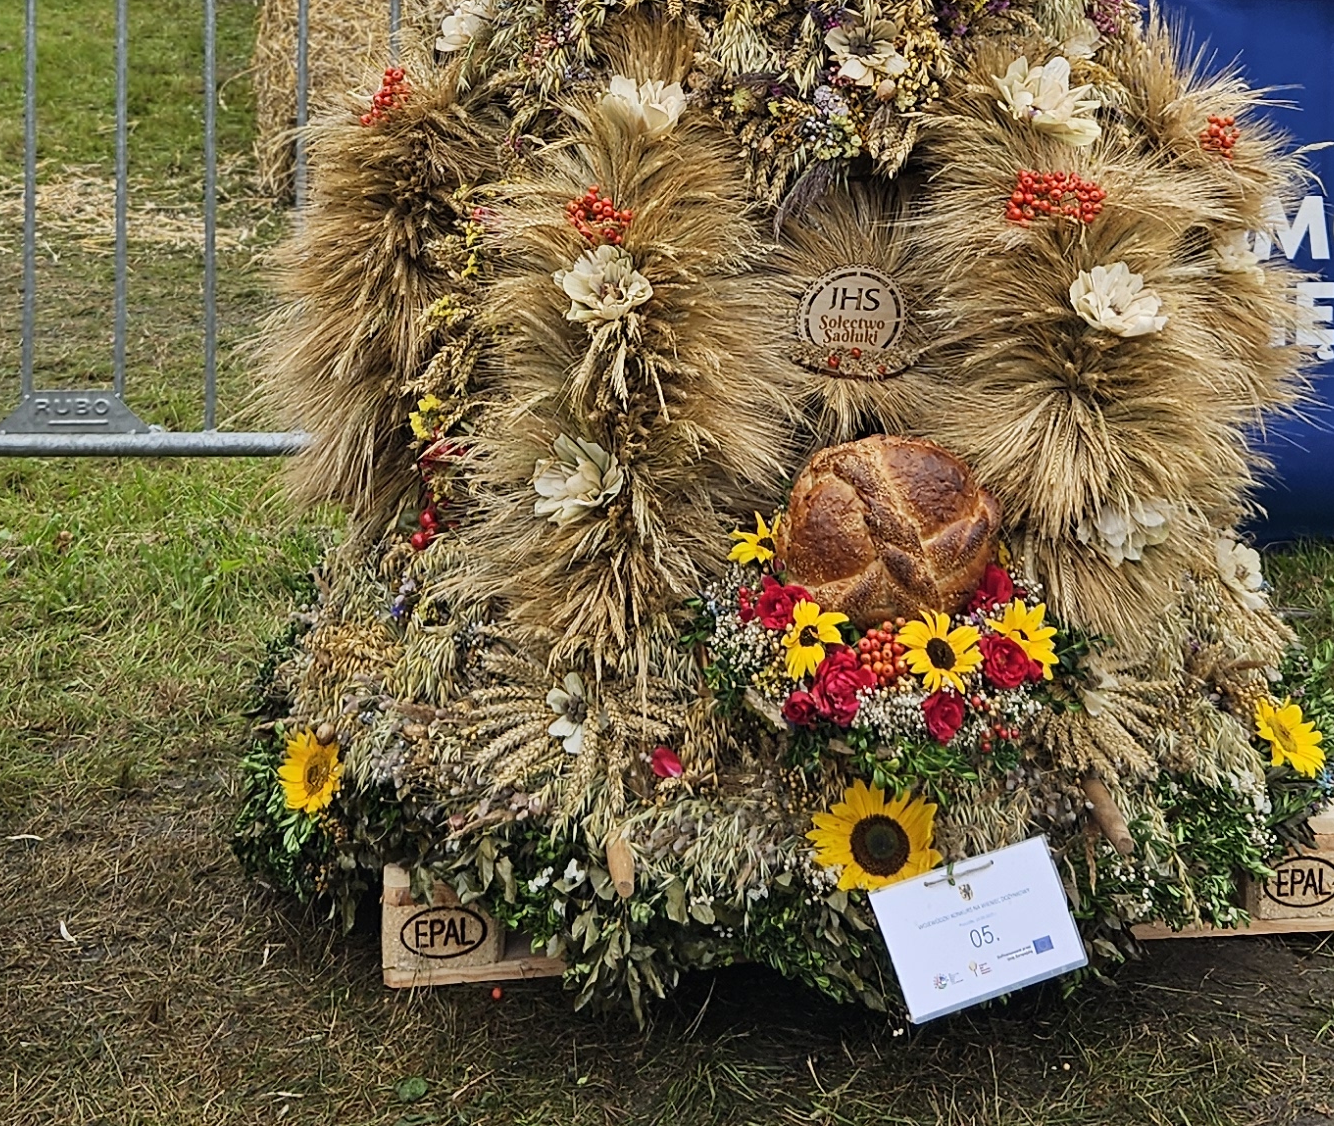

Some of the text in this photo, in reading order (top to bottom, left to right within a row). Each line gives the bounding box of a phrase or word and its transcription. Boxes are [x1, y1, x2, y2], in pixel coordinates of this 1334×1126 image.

[829, 286, 880, 312] JHS
[34, 398, 110, 415] RUBO
[1276, 867, 1332, 897] EPAL
[415, 917, 476, 949] EPAL
[969, 924, 1001, 949] 05.
